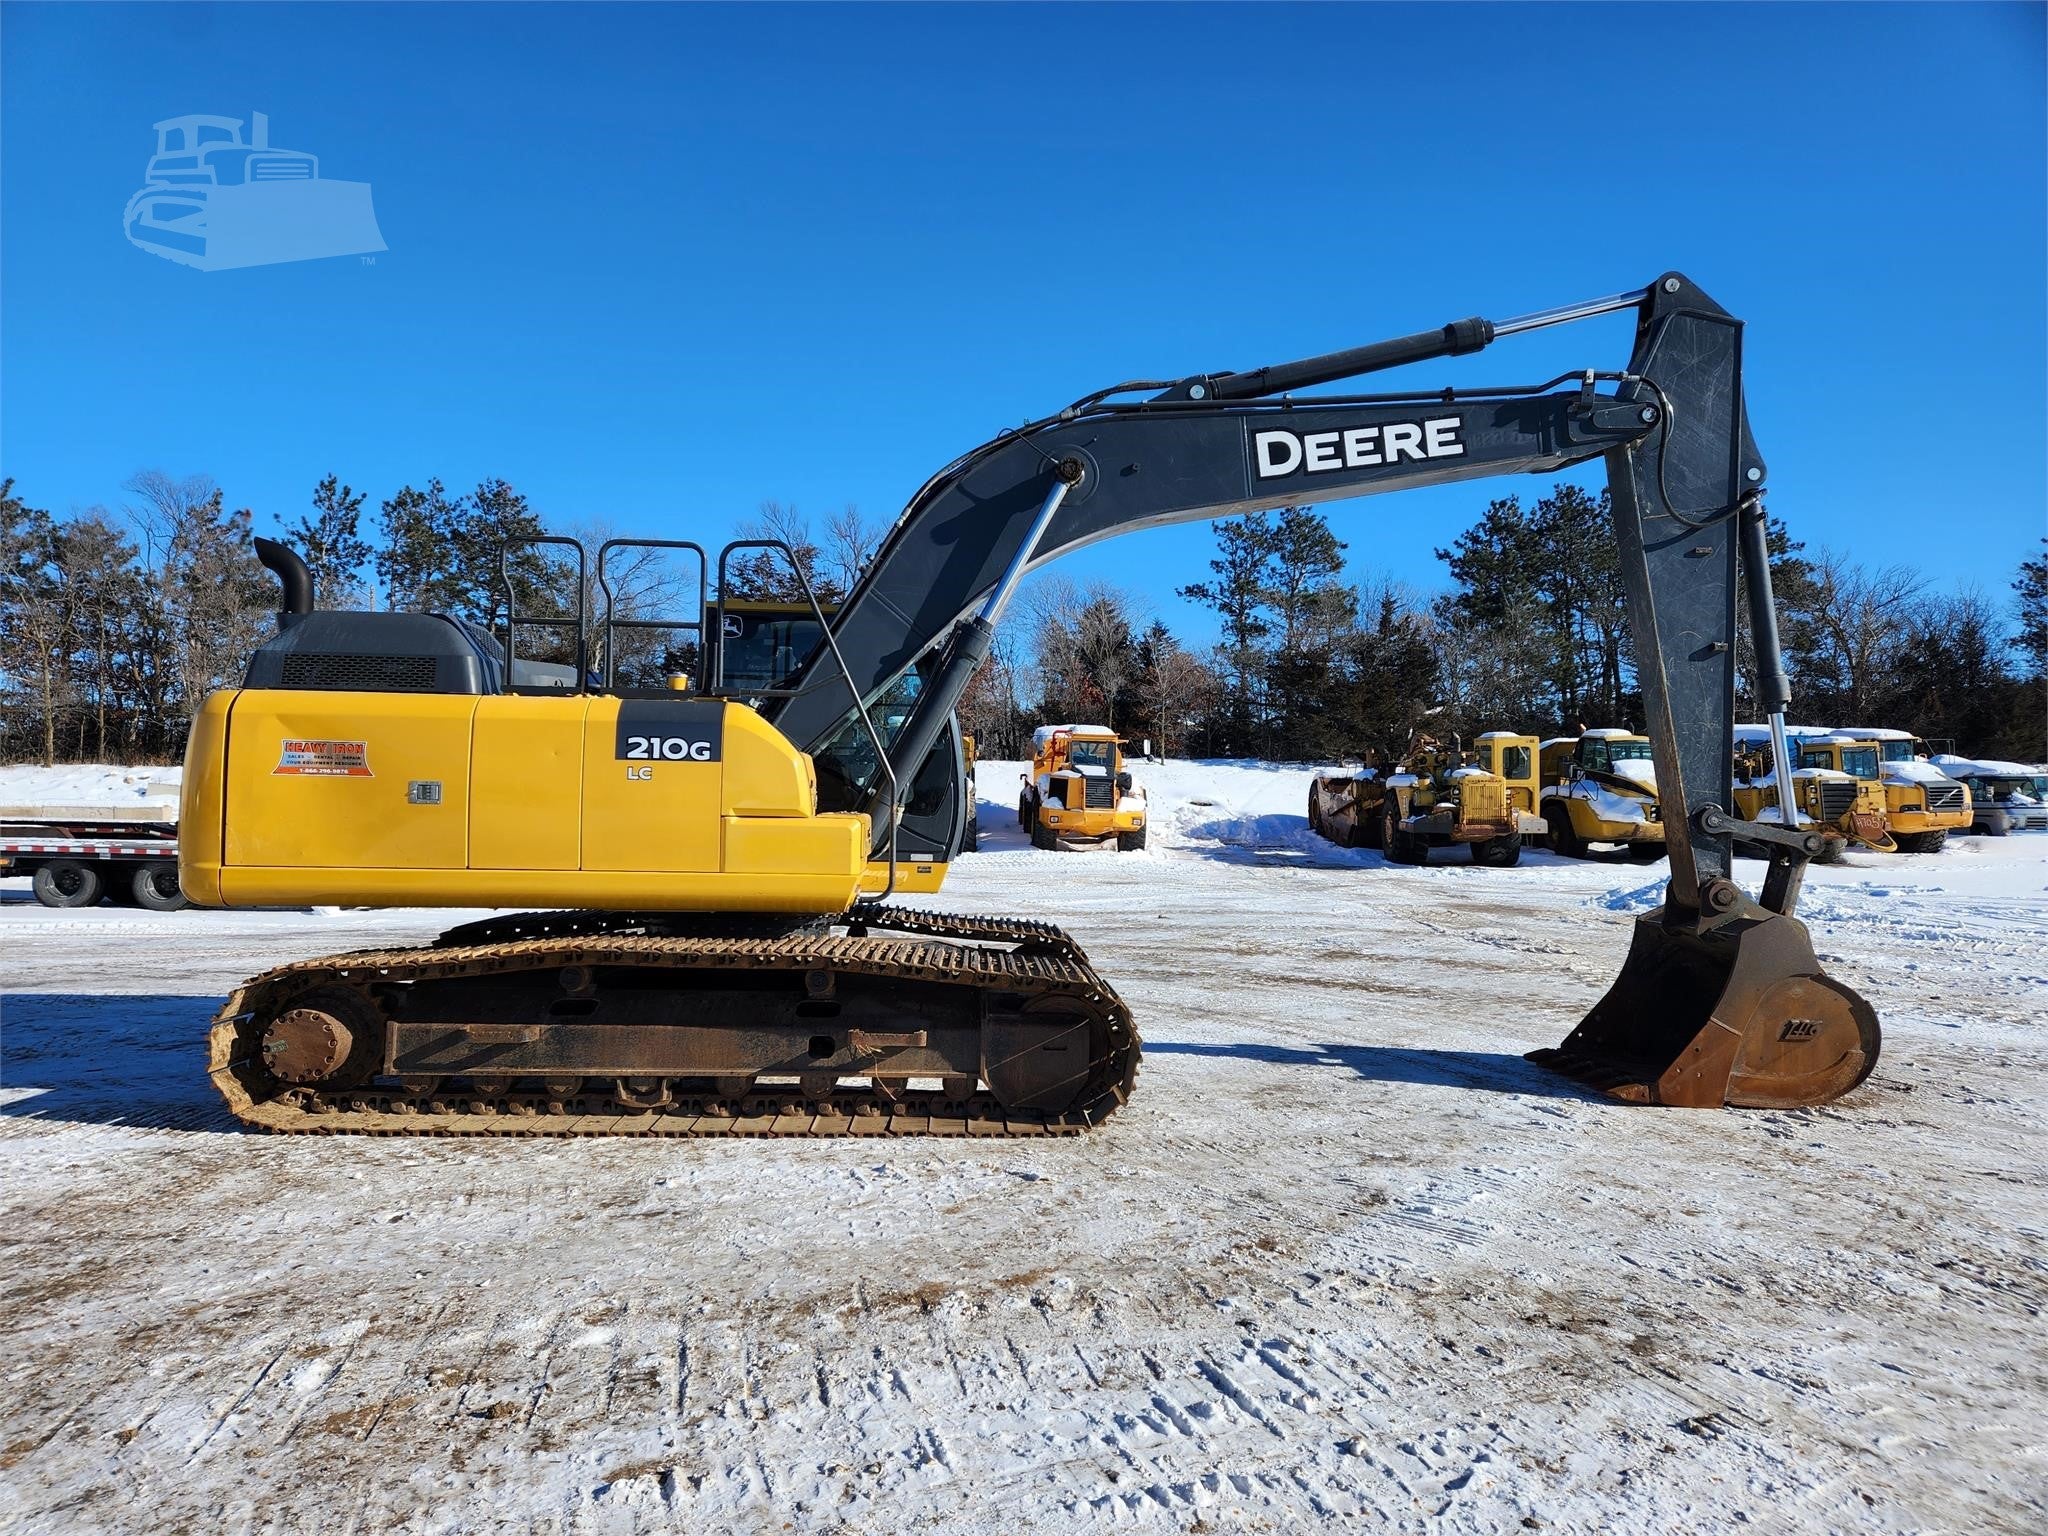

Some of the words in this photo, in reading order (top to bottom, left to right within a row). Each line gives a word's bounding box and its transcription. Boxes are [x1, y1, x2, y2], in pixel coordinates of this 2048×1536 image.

[1255, 417, 1464, 478] DEERE
[285, 742, 327, 753] HEAVY
[333, 743, 363, 754] IRON
[627, 736, 710, 761] 210G
[627, 766, 652, 780] LC
